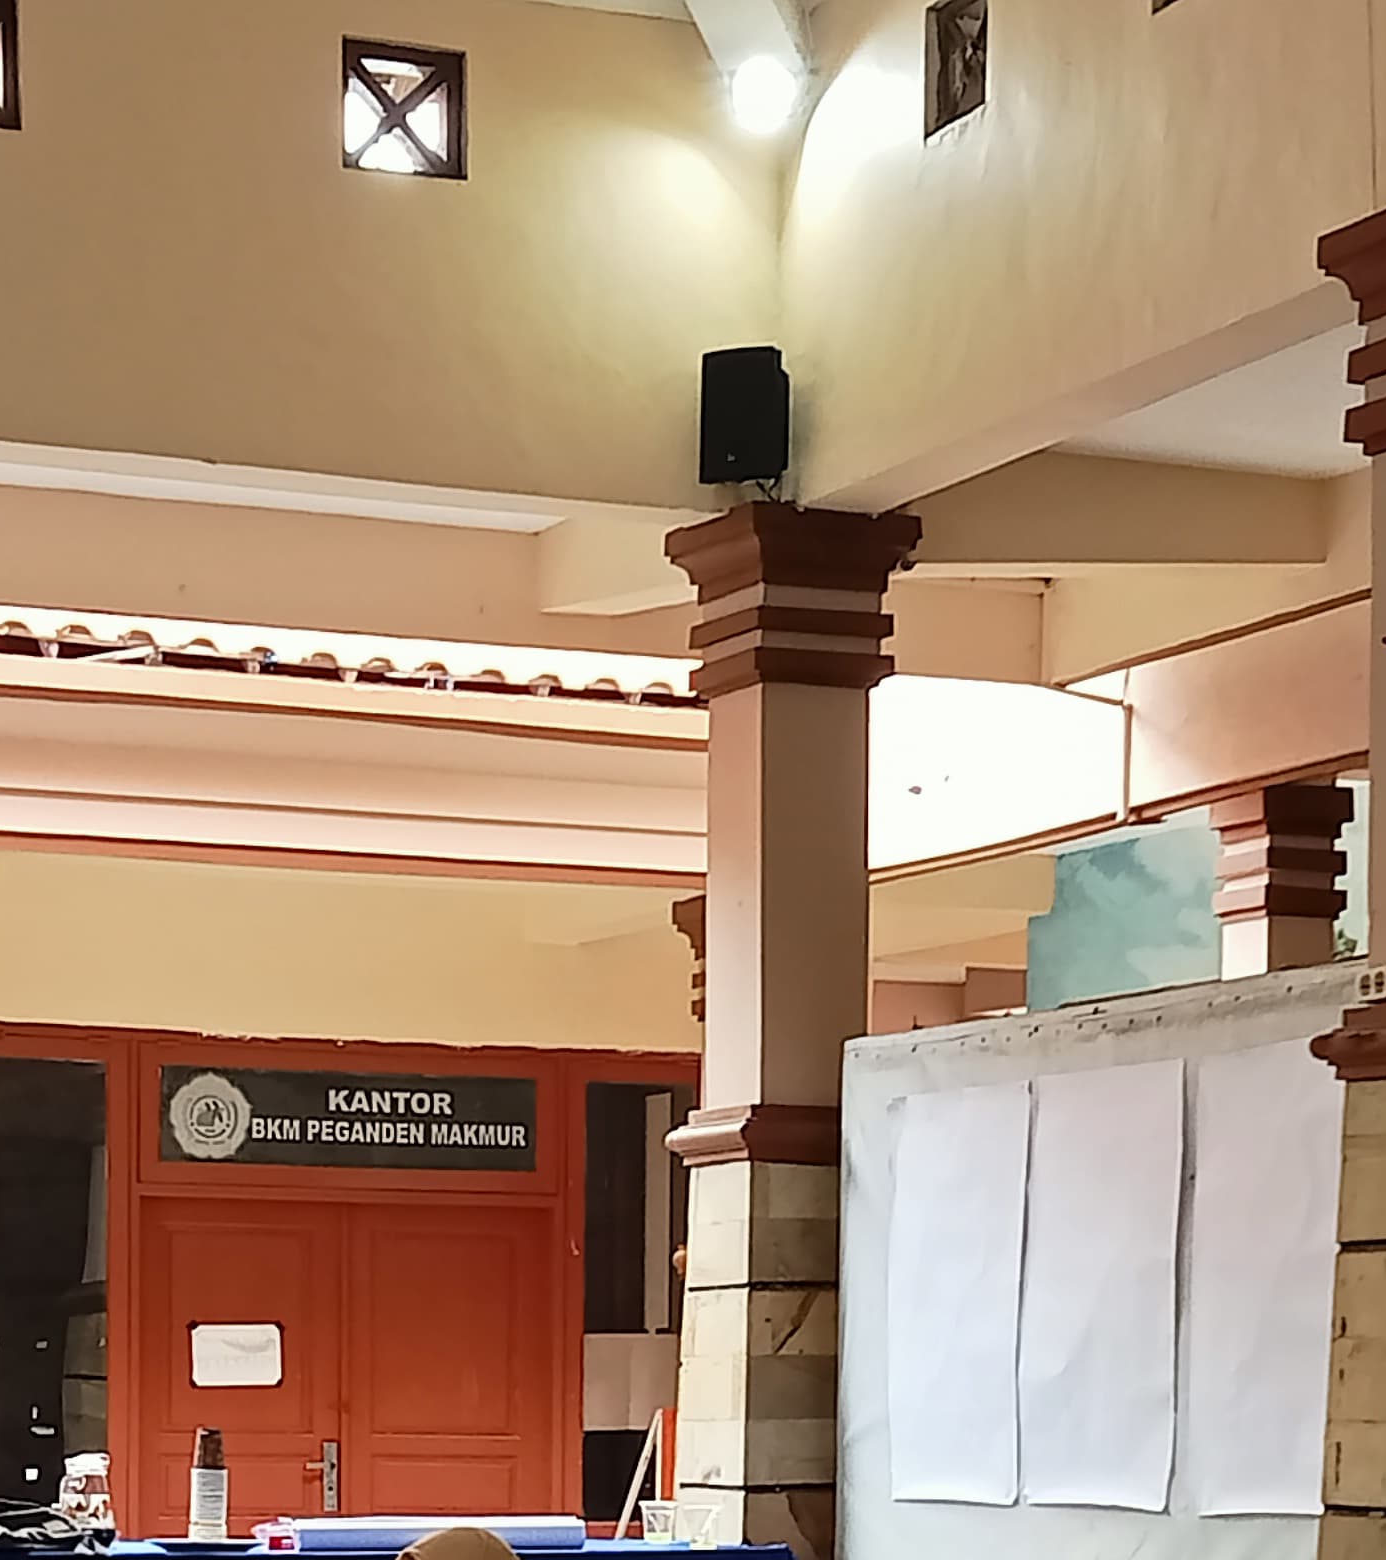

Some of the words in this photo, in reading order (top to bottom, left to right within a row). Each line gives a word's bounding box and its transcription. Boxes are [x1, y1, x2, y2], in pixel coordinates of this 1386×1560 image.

[327, 1088, 453, 1115] KANTOR
[251, 1118, 301, 1142] BKM
[306, 1119, 425, 1145] PEGANDEN
[431, 1123, 526, 1147] MAKMUR
